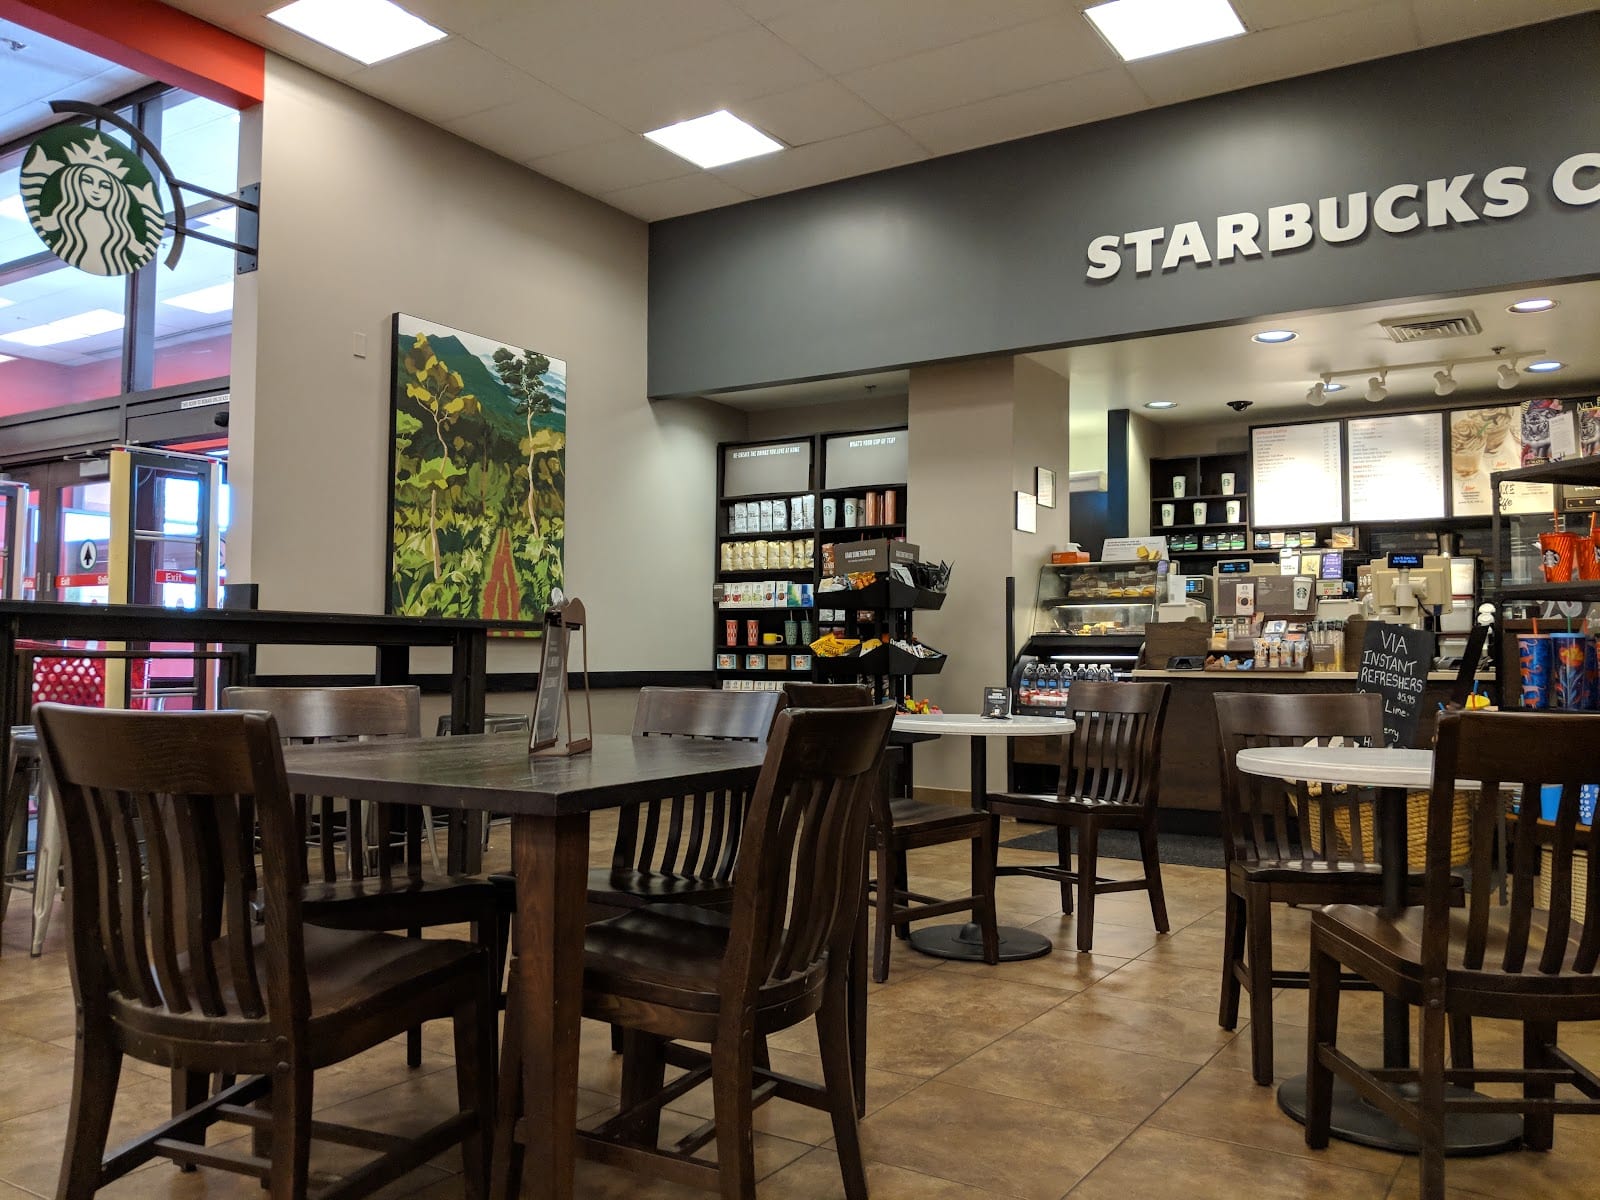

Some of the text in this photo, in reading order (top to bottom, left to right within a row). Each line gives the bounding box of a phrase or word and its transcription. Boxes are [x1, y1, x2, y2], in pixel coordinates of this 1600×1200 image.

[1086, 166, 1529, 279] STARBUCKS
[166, 572, 182, 582] Exit
[1381, 630, 1408, 655] VIA
[1362, 650, 1417, 676] INSTANT
[1360, 667, 1423, 693] REFRESHERS
